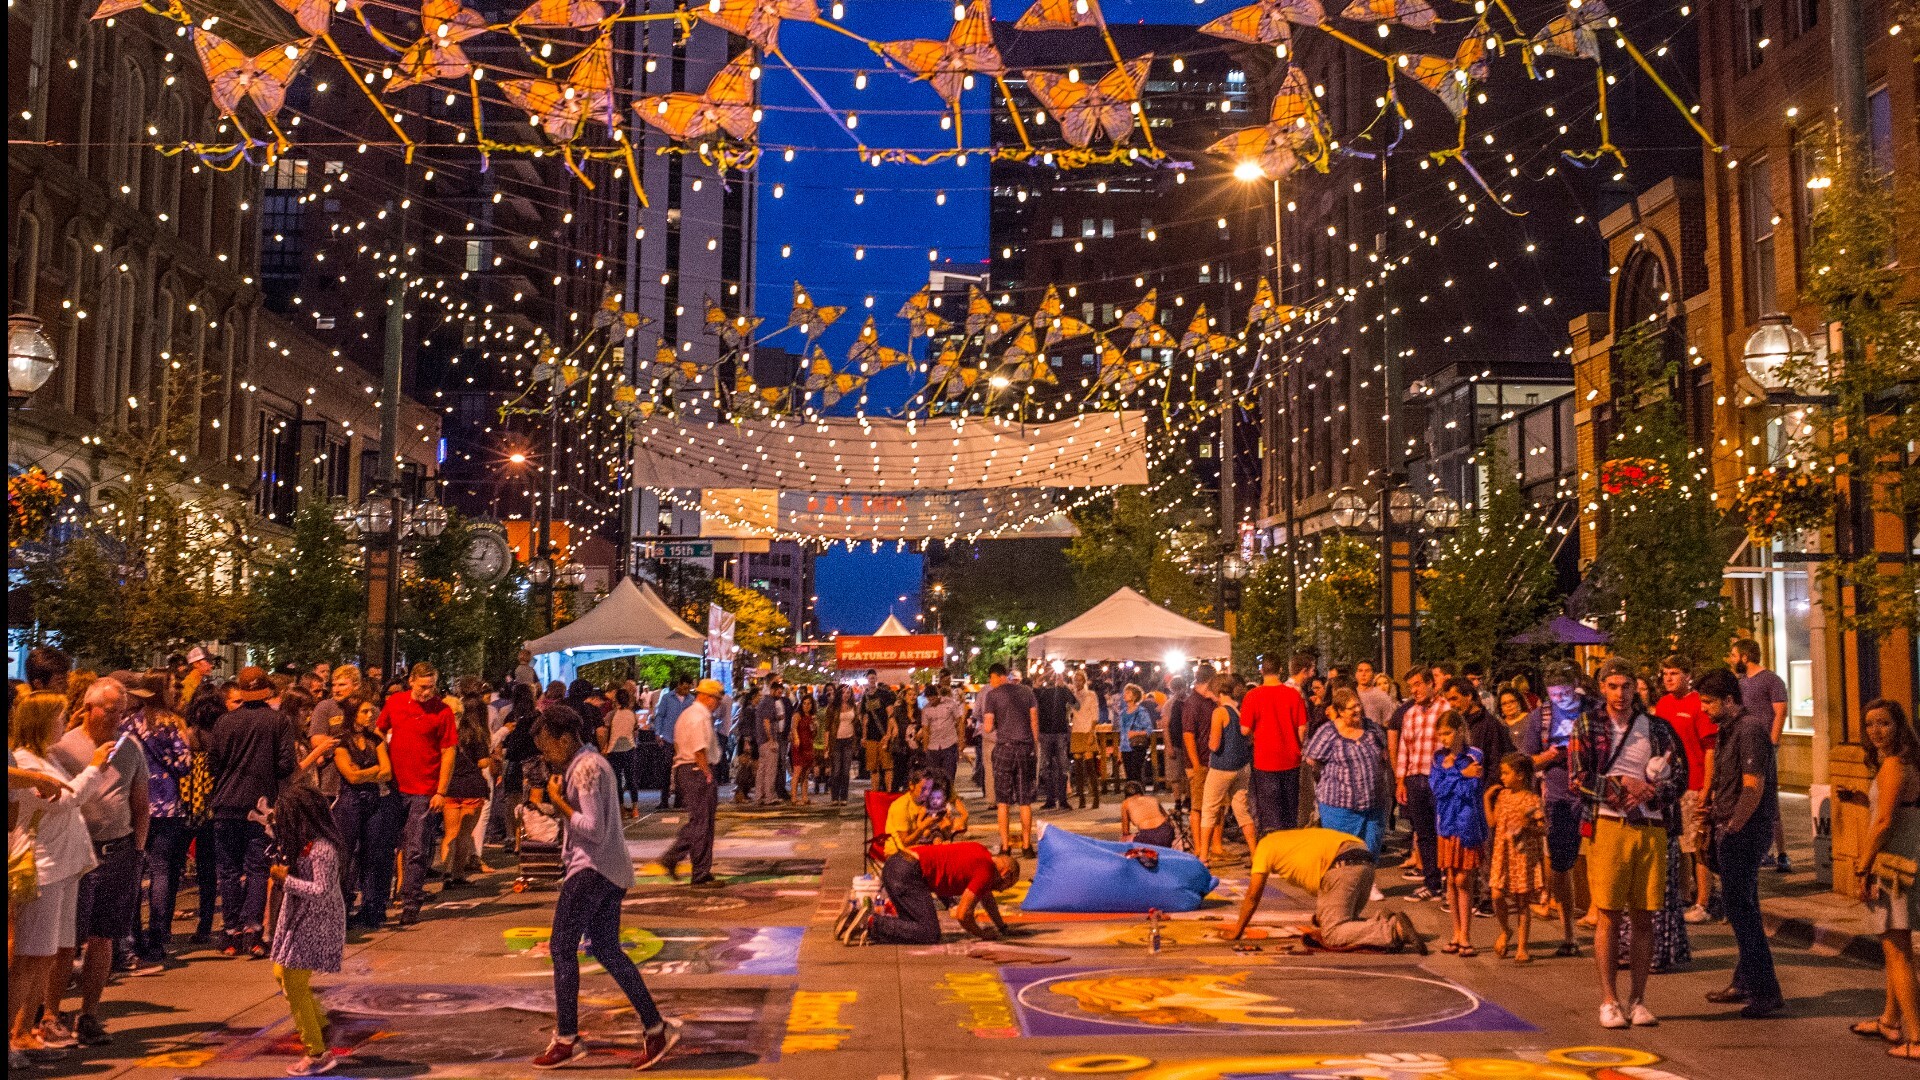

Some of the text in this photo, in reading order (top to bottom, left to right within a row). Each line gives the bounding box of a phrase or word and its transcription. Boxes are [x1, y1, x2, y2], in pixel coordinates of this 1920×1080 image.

[669, 545, 695, 556] 15th
[841, 650, 939, 661] FEATURED ARTIST
